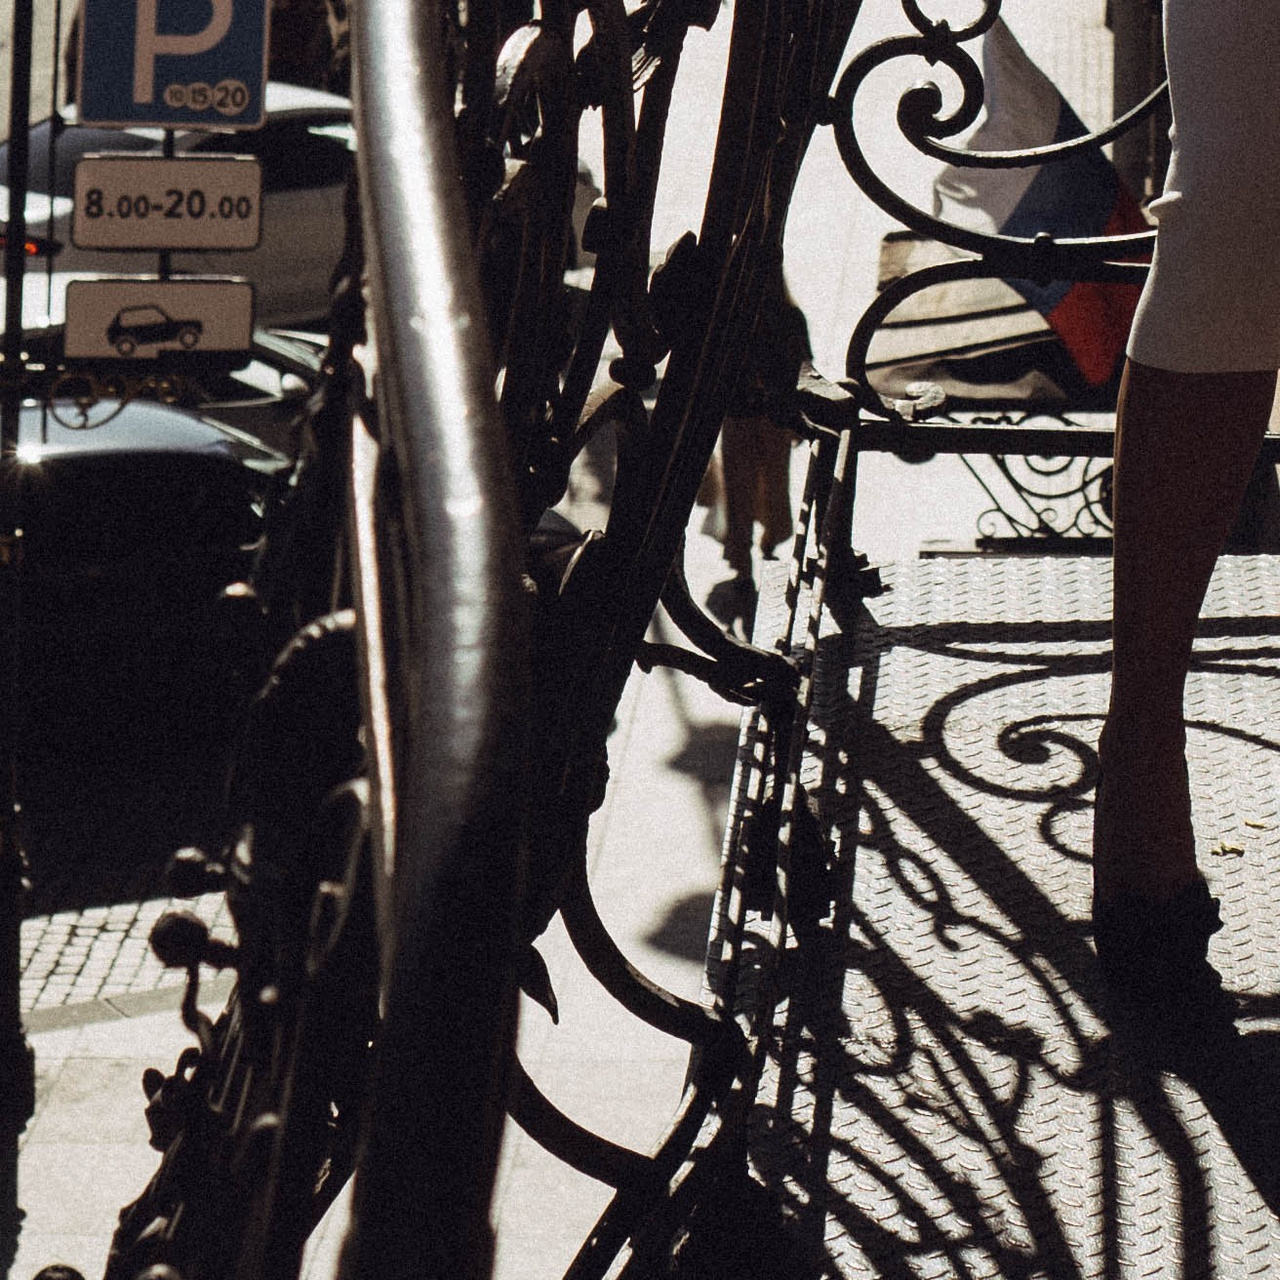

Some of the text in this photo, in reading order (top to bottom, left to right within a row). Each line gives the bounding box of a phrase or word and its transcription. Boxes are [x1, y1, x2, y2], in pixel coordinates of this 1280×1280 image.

[191, 86, 208, 104] 15
[216, 85, 247, 108] 20
[85, 188, 252, 219] 8.00-20.00
